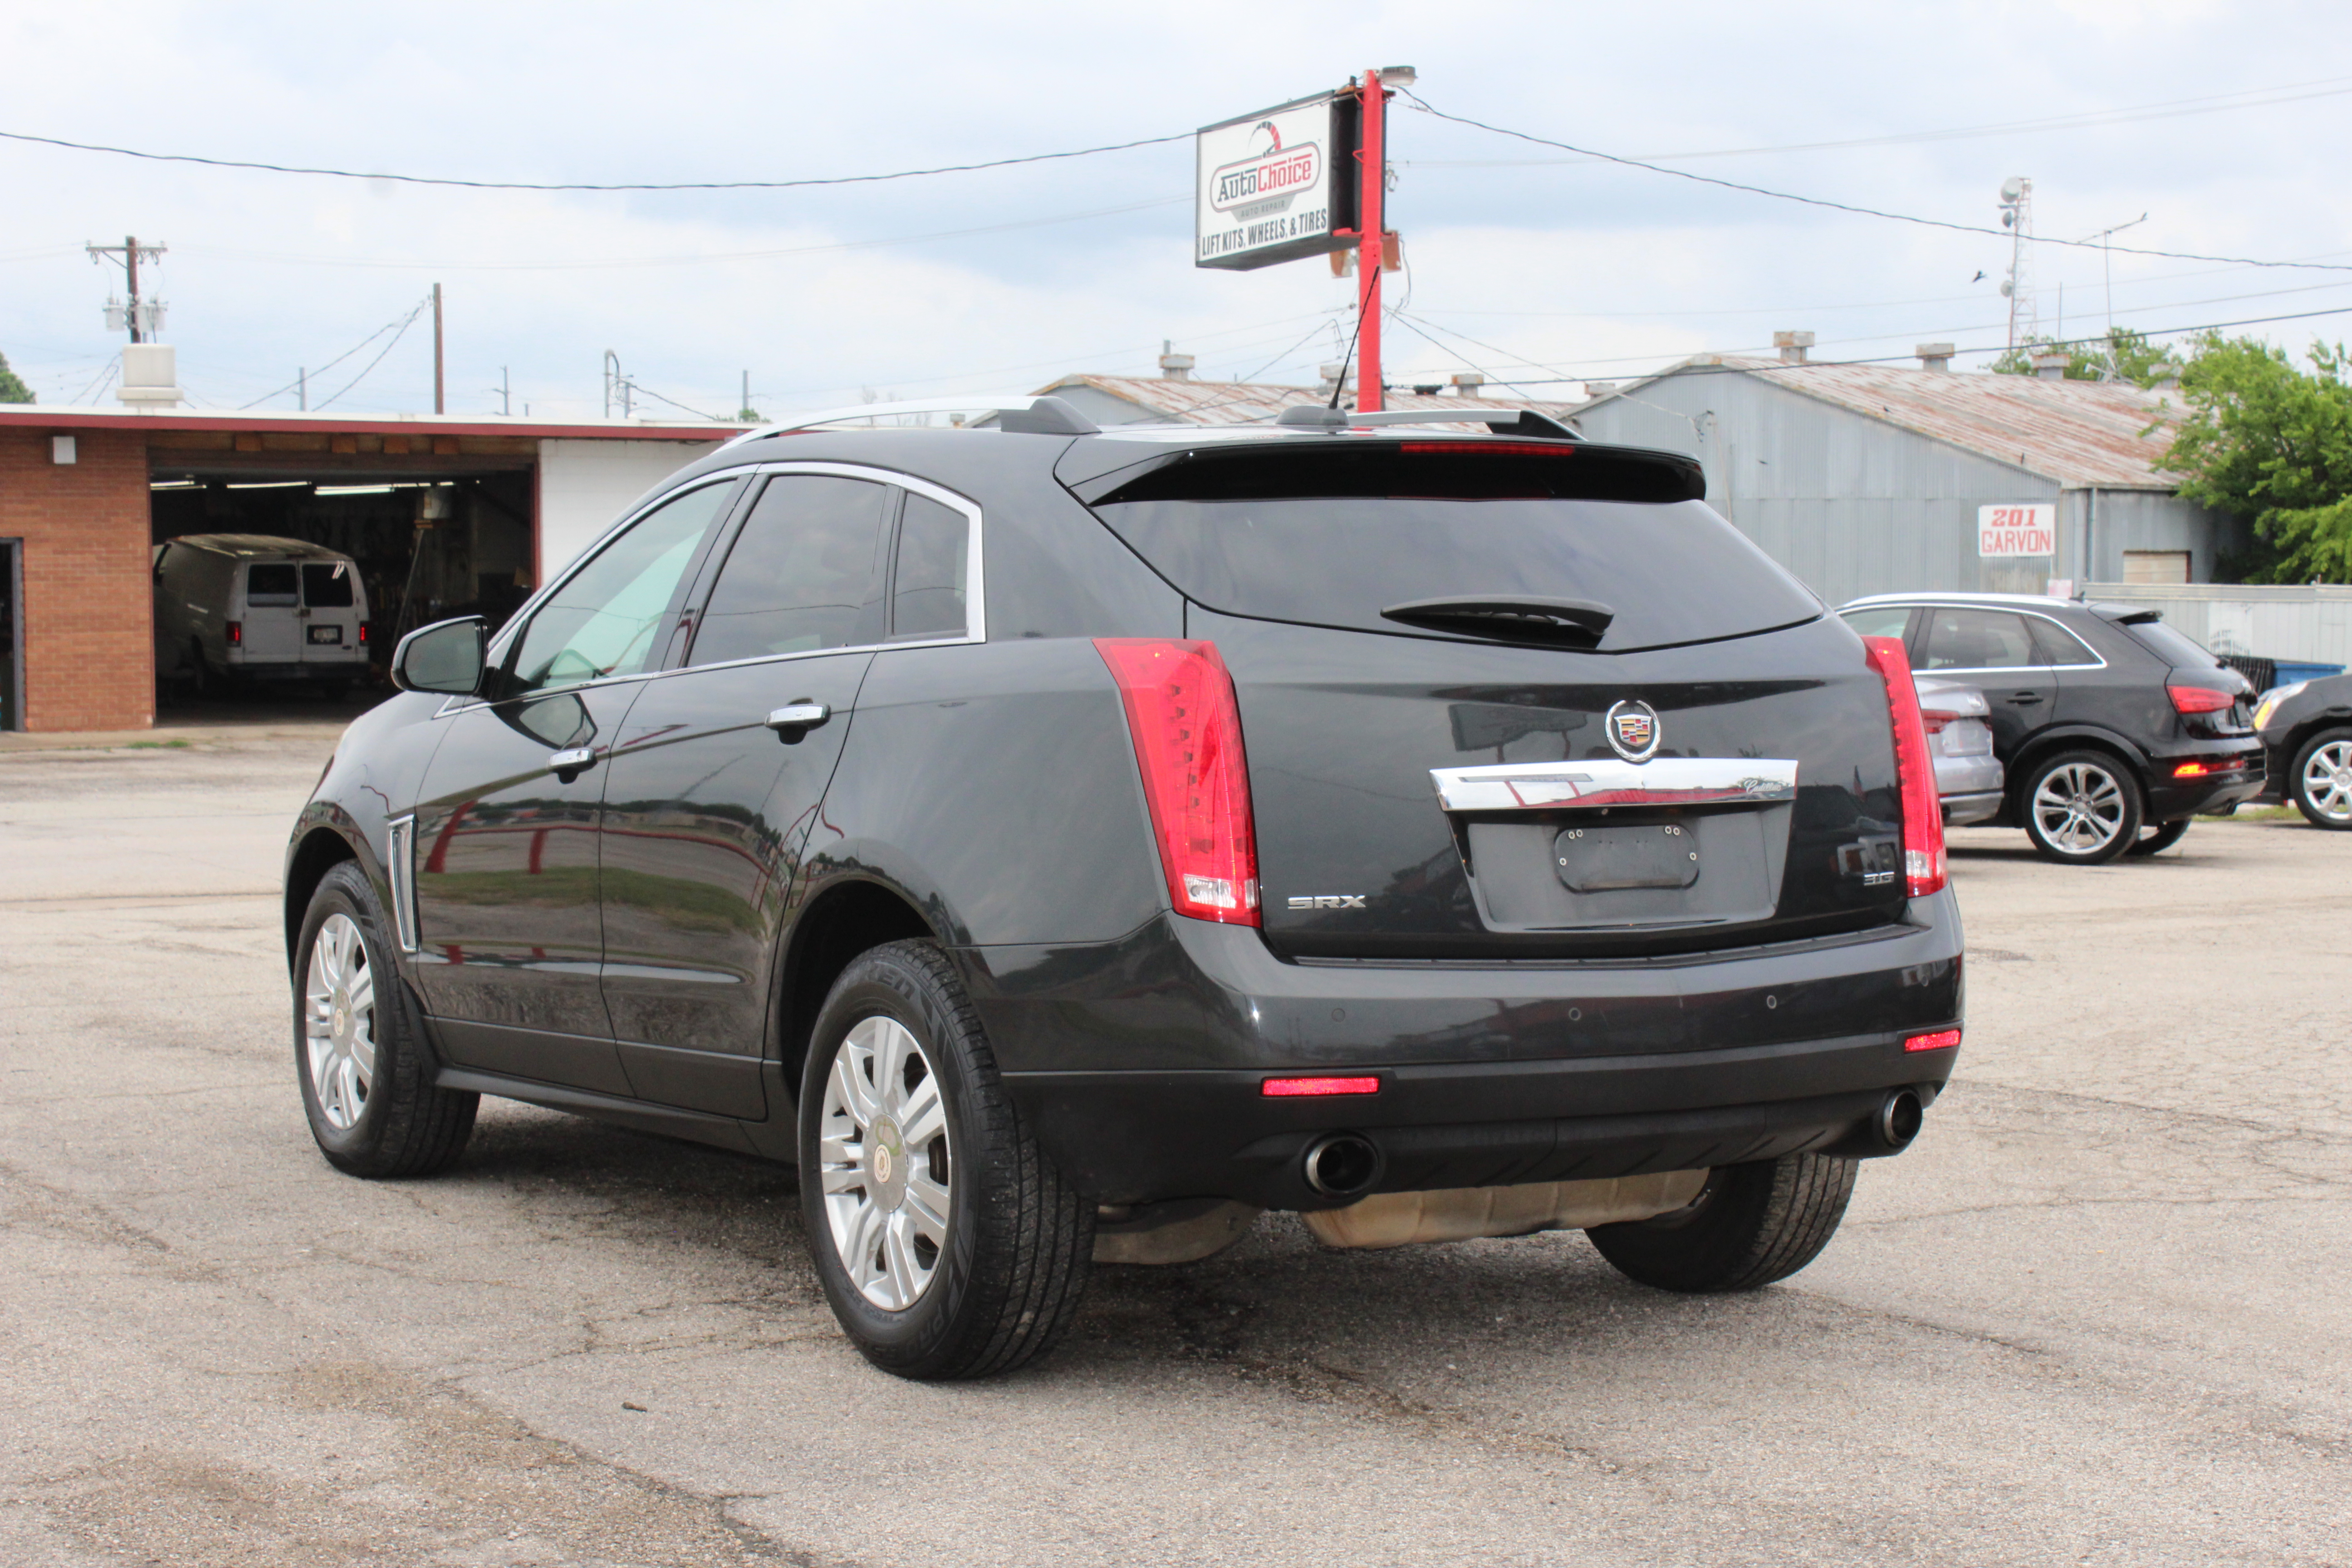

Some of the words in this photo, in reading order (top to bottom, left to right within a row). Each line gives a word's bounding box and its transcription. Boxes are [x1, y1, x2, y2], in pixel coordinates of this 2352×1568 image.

[1217, 154, 1312, 202] AutoChoice
[1241, 207, 1259, 217] AUTO
[1261, 200, 1285, 212] REPAIR
[1202, 233, 1220, 256] LIFT
[1222, 228, 1246, 251] KITS,
[1248, 218, 1288, 245] WHEELS,
[1290, 216, 1297, 236] &
[1299, 208, 1327, 234] TIRES
[1991, 509, 2037, 527] 201
[1981, 529, 2051, 553] GARVON
[1744, 779, 1781, 794] Cadillac
[1288, 895, 1366, 910] SRX
